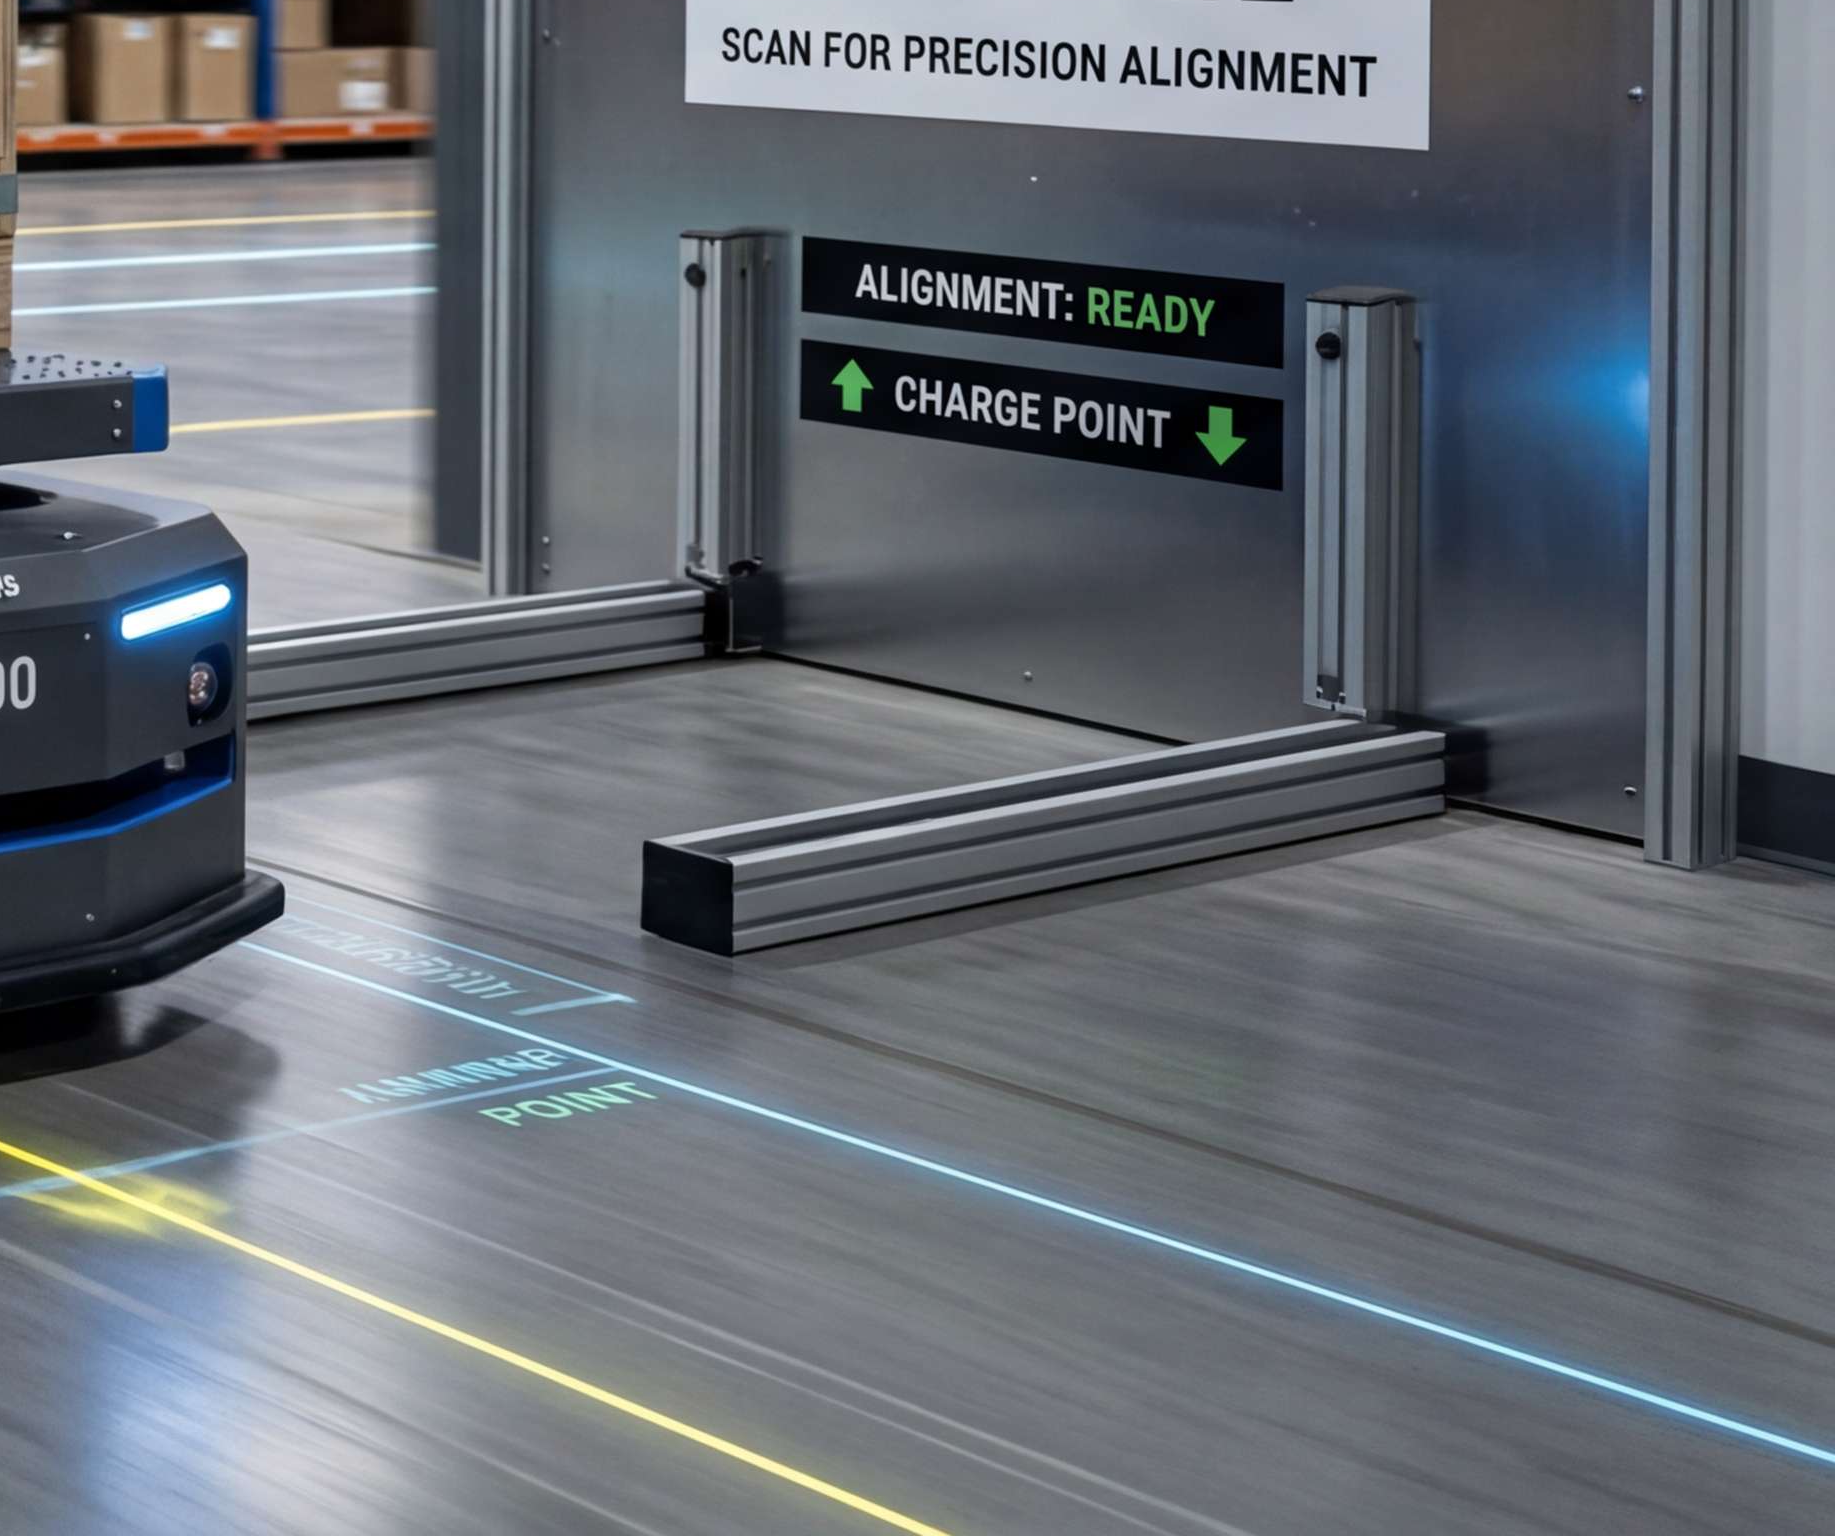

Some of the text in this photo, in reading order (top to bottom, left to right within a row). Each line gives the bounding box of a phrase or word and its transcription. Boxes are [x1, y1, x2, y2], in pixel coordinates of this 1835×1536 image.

[721, 27, 1377, 98] SCAN FOR PRECISION ALIGNMENT
[855, 264, 1216, 337] ALIGNMENT: READY
[895, 375, 1171, 449] CHARGE POINT
[477, 1081, 659, 1127] POINT
